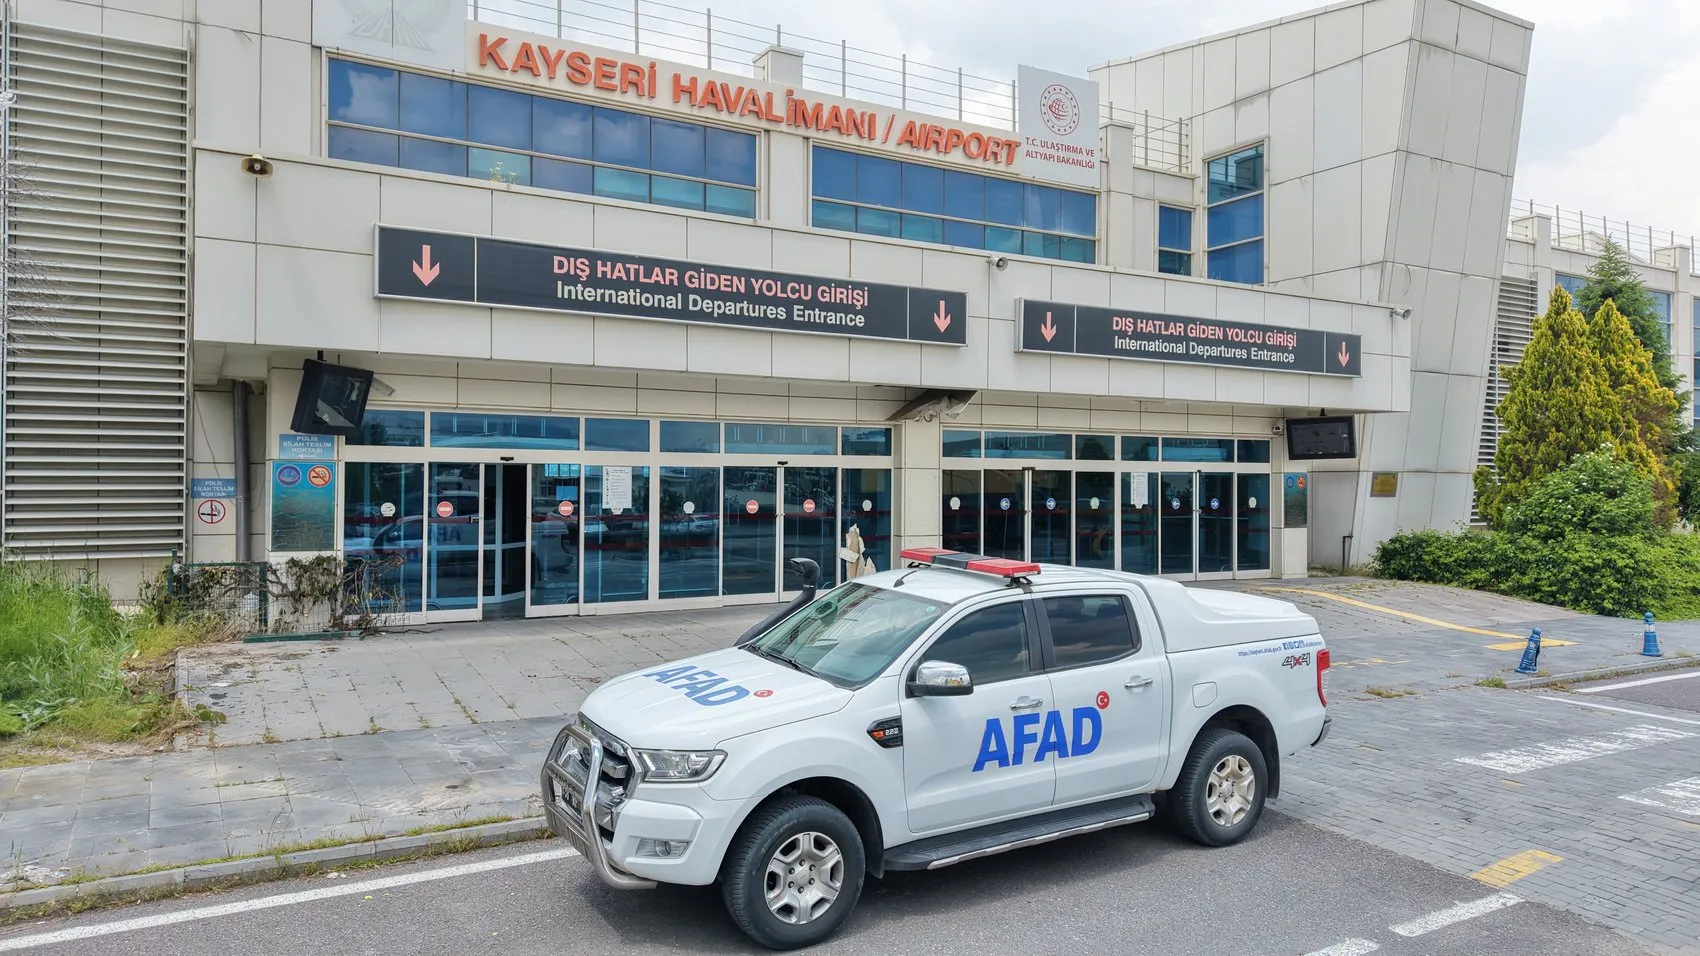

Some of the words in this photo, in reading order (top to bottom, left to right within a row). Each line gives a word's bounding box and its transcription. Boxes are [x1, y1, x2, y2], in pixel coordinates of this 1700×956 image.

[479, 33, 657, 99] KAYSERİ
[672, 72, 876, 141] HAVALİMANI
[882, 113, 896, 144] /
[897, 120, 1022, 166] AIRPORT
[1025, 137, 1039, 147] T.C.
[1040, 140, 1083, 154] ULAŞTIRMA
[1085, 148, 1095, 157] VE
[1025, 150, 1055, 162] ALTYAPI
[1056, 156, 1095, 170] BAKANLIĞI
[553, 255, 590, 281] DIŞ
[597, 260, 678, 286] HATLAR
[684, 268, 746, 294] GİDEN
[750, 278, 812, 301] YOLCU
[817, 283, 869, 309] GİRİŞİ
[557, 281, 682, 310] International
[688, 294, 787, 320] Departures
[793, 305, 865, 327] Entrance
[1112, 316, 1134, 335] DIŞ
[1137, 319, 1184, 337] HATLAR
[1187, 321, 1223, 340] GİDEN
[1226, 327, 1263, 345] YOLCU
[1265, 330, 1297, 350] GİRİŞİ
[1114, 336, 1186, 354] International
[1189, 342, 1247, 360] Departures
[1250, 347, 1295, 364] Entrance
[642, 665, 750, 707] AFAD
[971, 706, 1103, 773] AFAD
